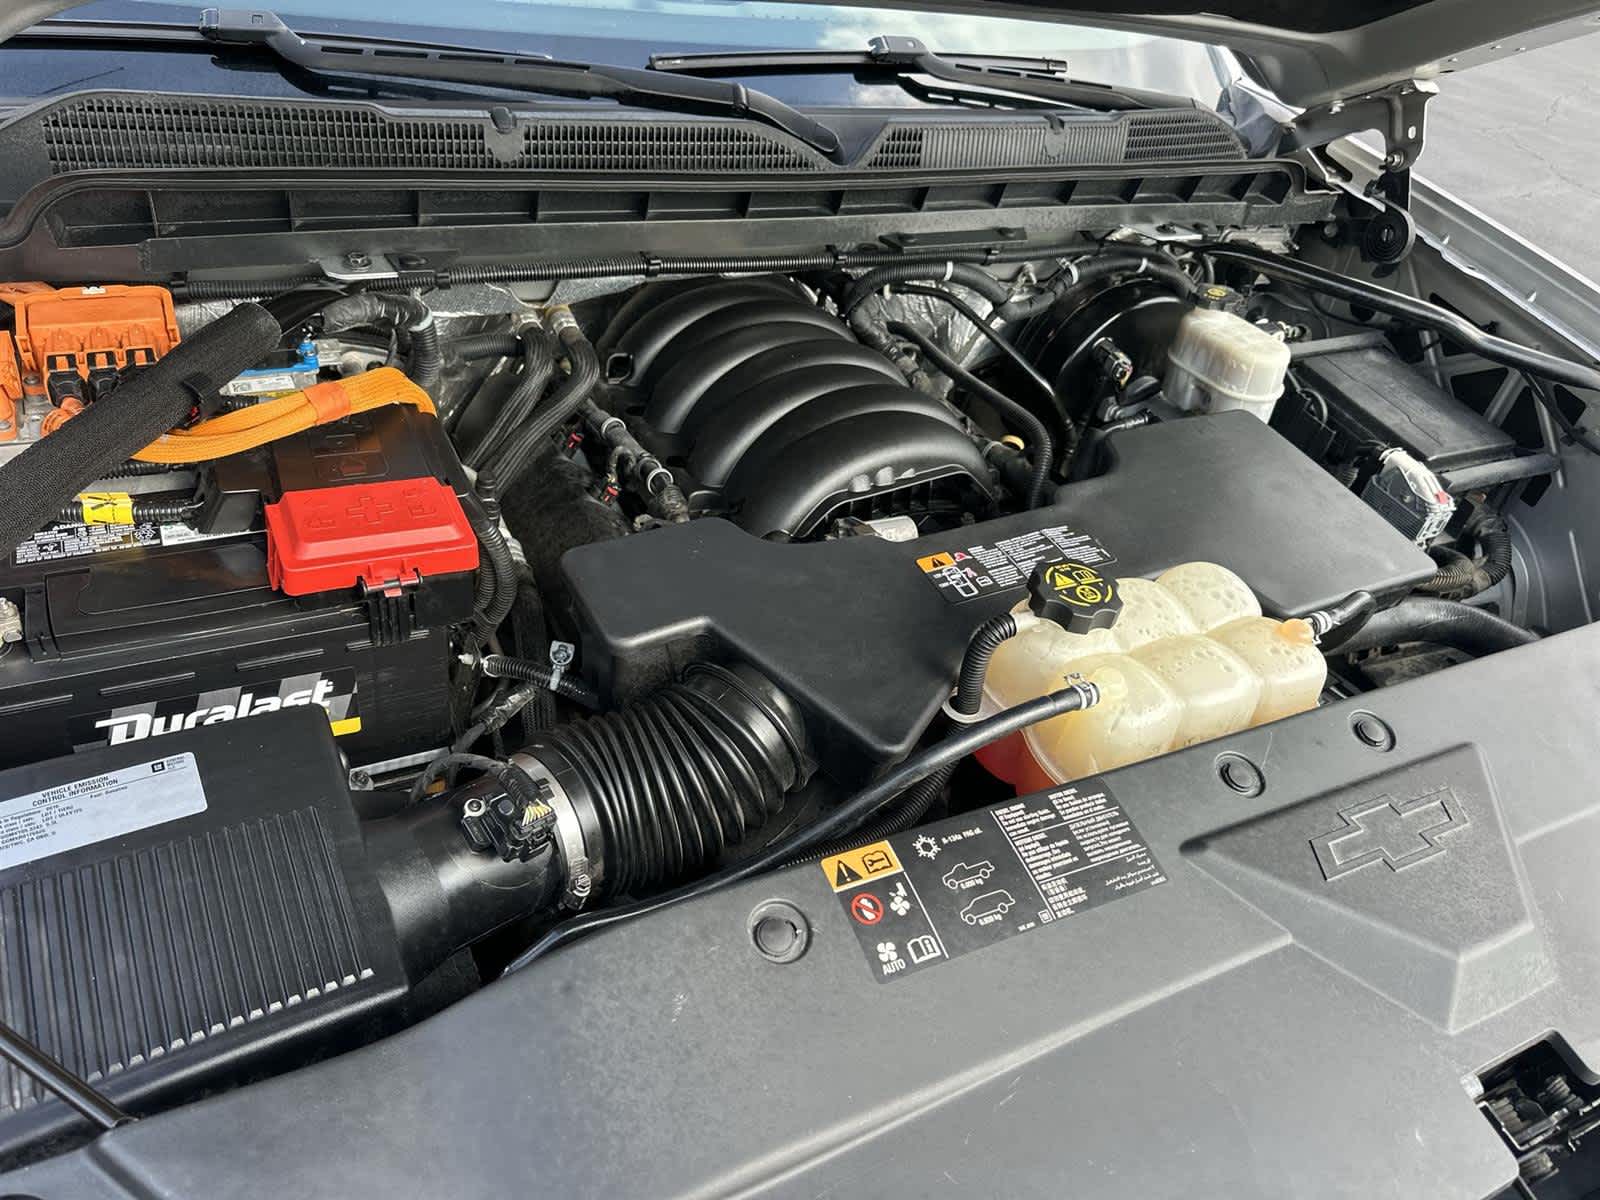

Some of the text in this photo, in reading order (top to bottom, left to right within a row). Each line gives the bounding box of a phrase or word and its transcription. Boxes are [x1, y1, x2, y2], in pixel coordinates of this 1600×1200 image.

[95, 679, 334, 746] Duralast
[32, 779, 119, 807] CONTROL INFORMATION
[42, 775, 109, 798] VEHICLE EMISSION
[882, 958, 906, 975] AUTO
